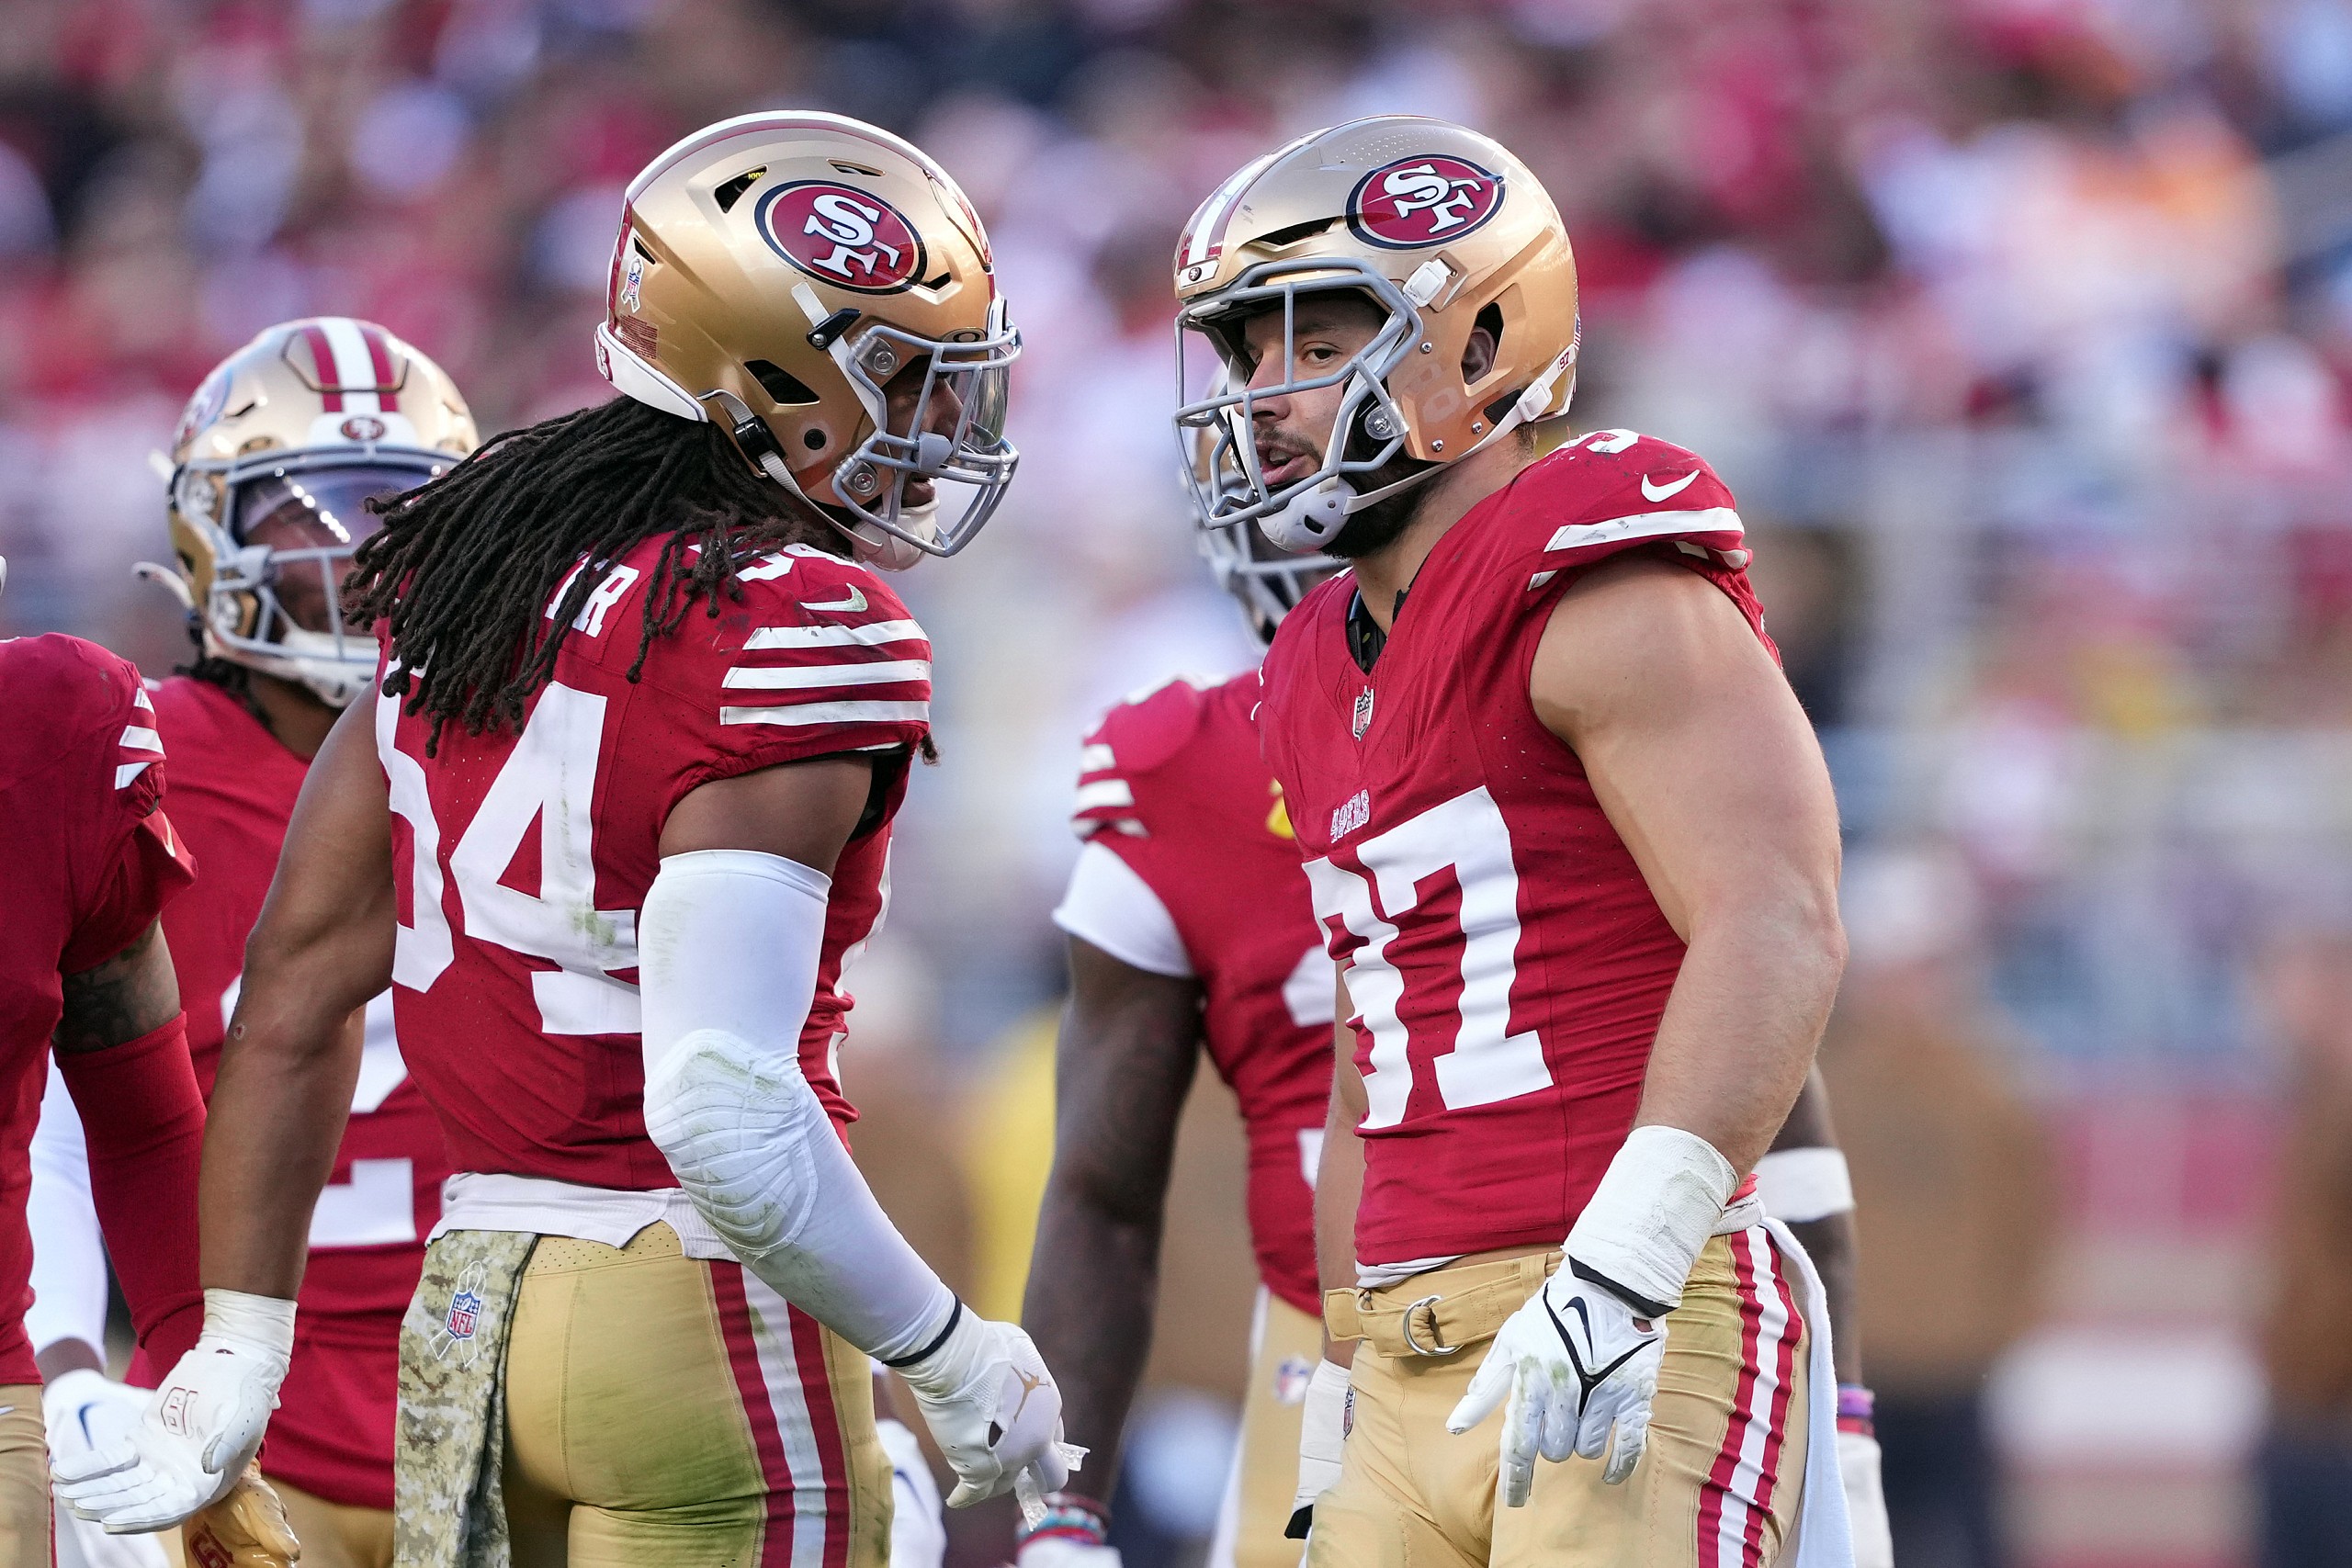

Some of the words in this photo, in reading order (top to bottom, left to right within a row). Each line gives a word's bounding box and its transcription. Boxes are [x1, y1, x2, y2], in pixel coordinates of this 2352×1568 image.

[1383, 164, 1482, 234] SF
[803, 193, 901, 278] SF
[1559, 351, 1570, 369] 97
[375, 639, 641, 1035] 54
[1329, 788, 1371, 844] 49ERS
[1301, 784, 1555, 1130] 97
[449, 1309, 474, 1335] NFL
